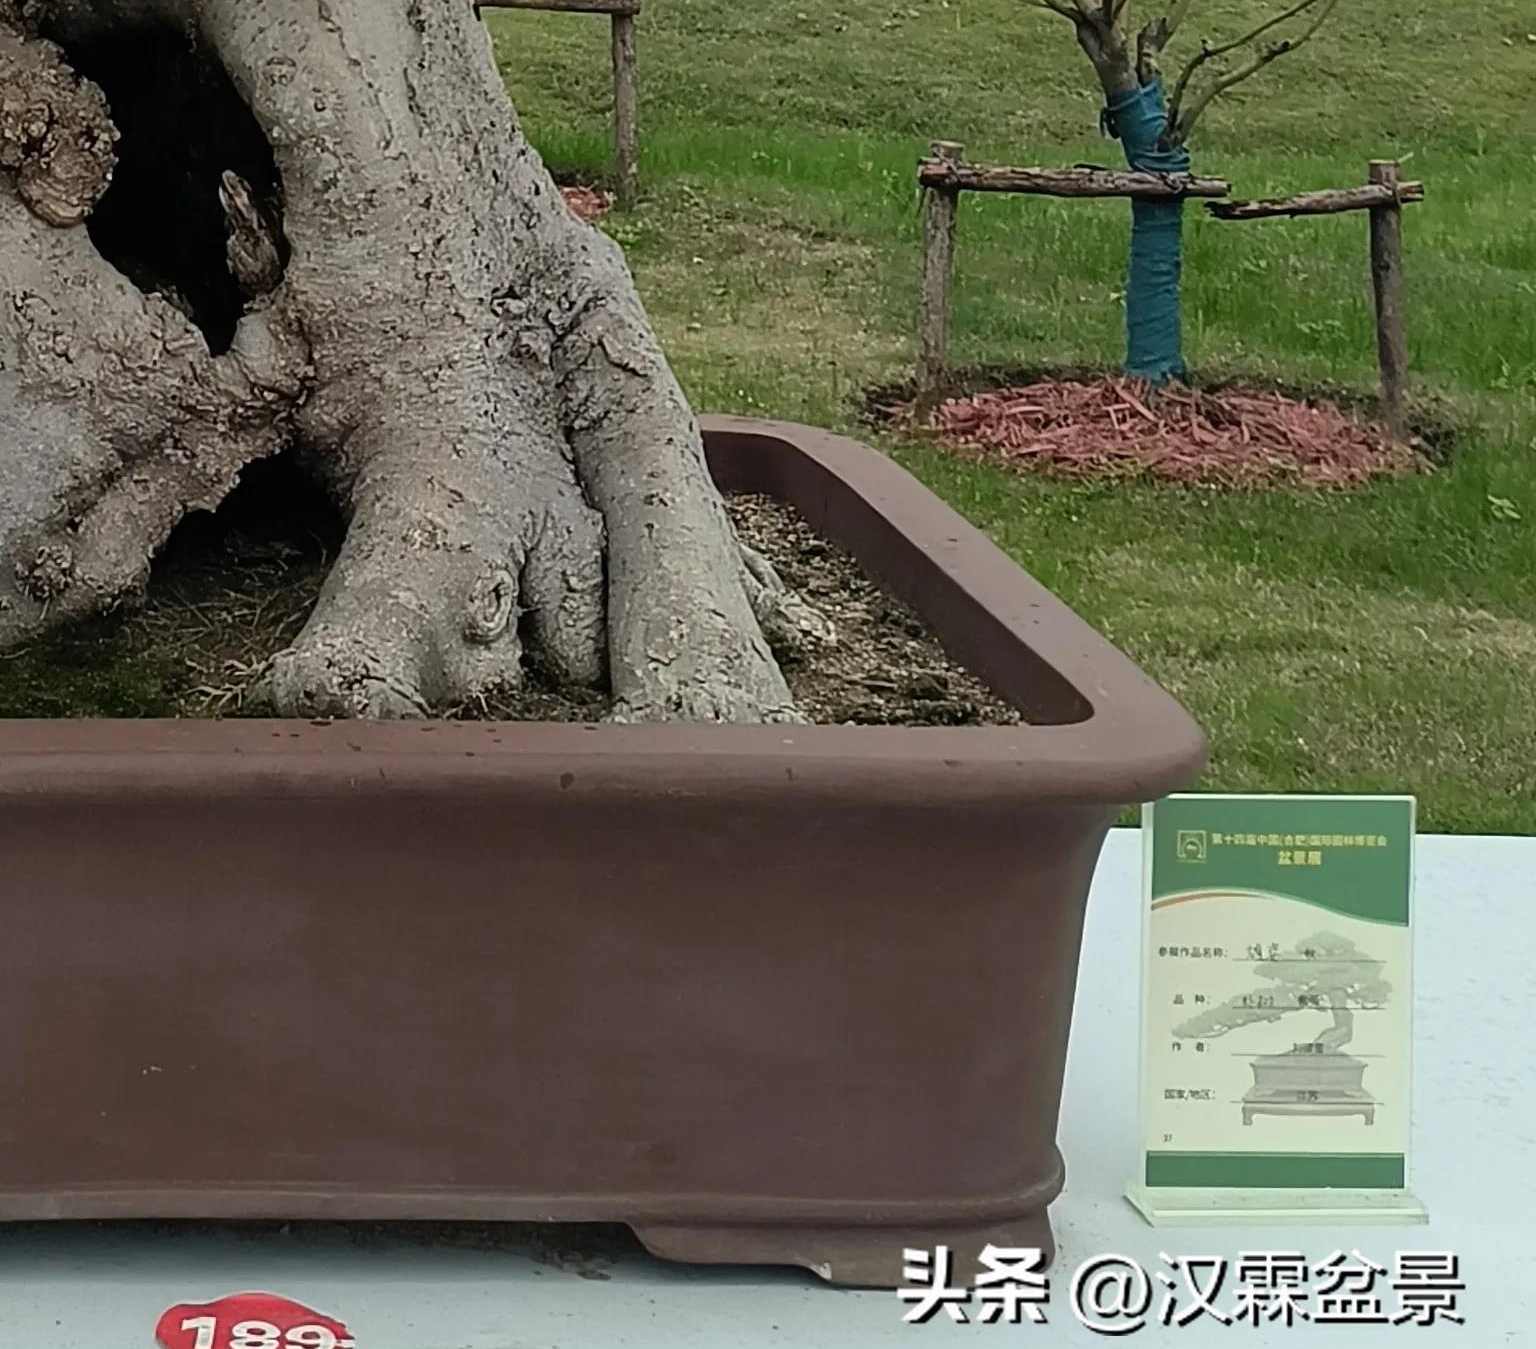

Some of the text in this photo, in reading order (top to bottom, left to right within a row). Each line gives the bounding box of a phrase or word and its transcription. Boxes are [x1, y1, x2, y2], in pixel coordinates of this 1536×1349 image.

[1277, 850, 1322, 865] 盆景展
[181, 1316, 337, 1349] 189
